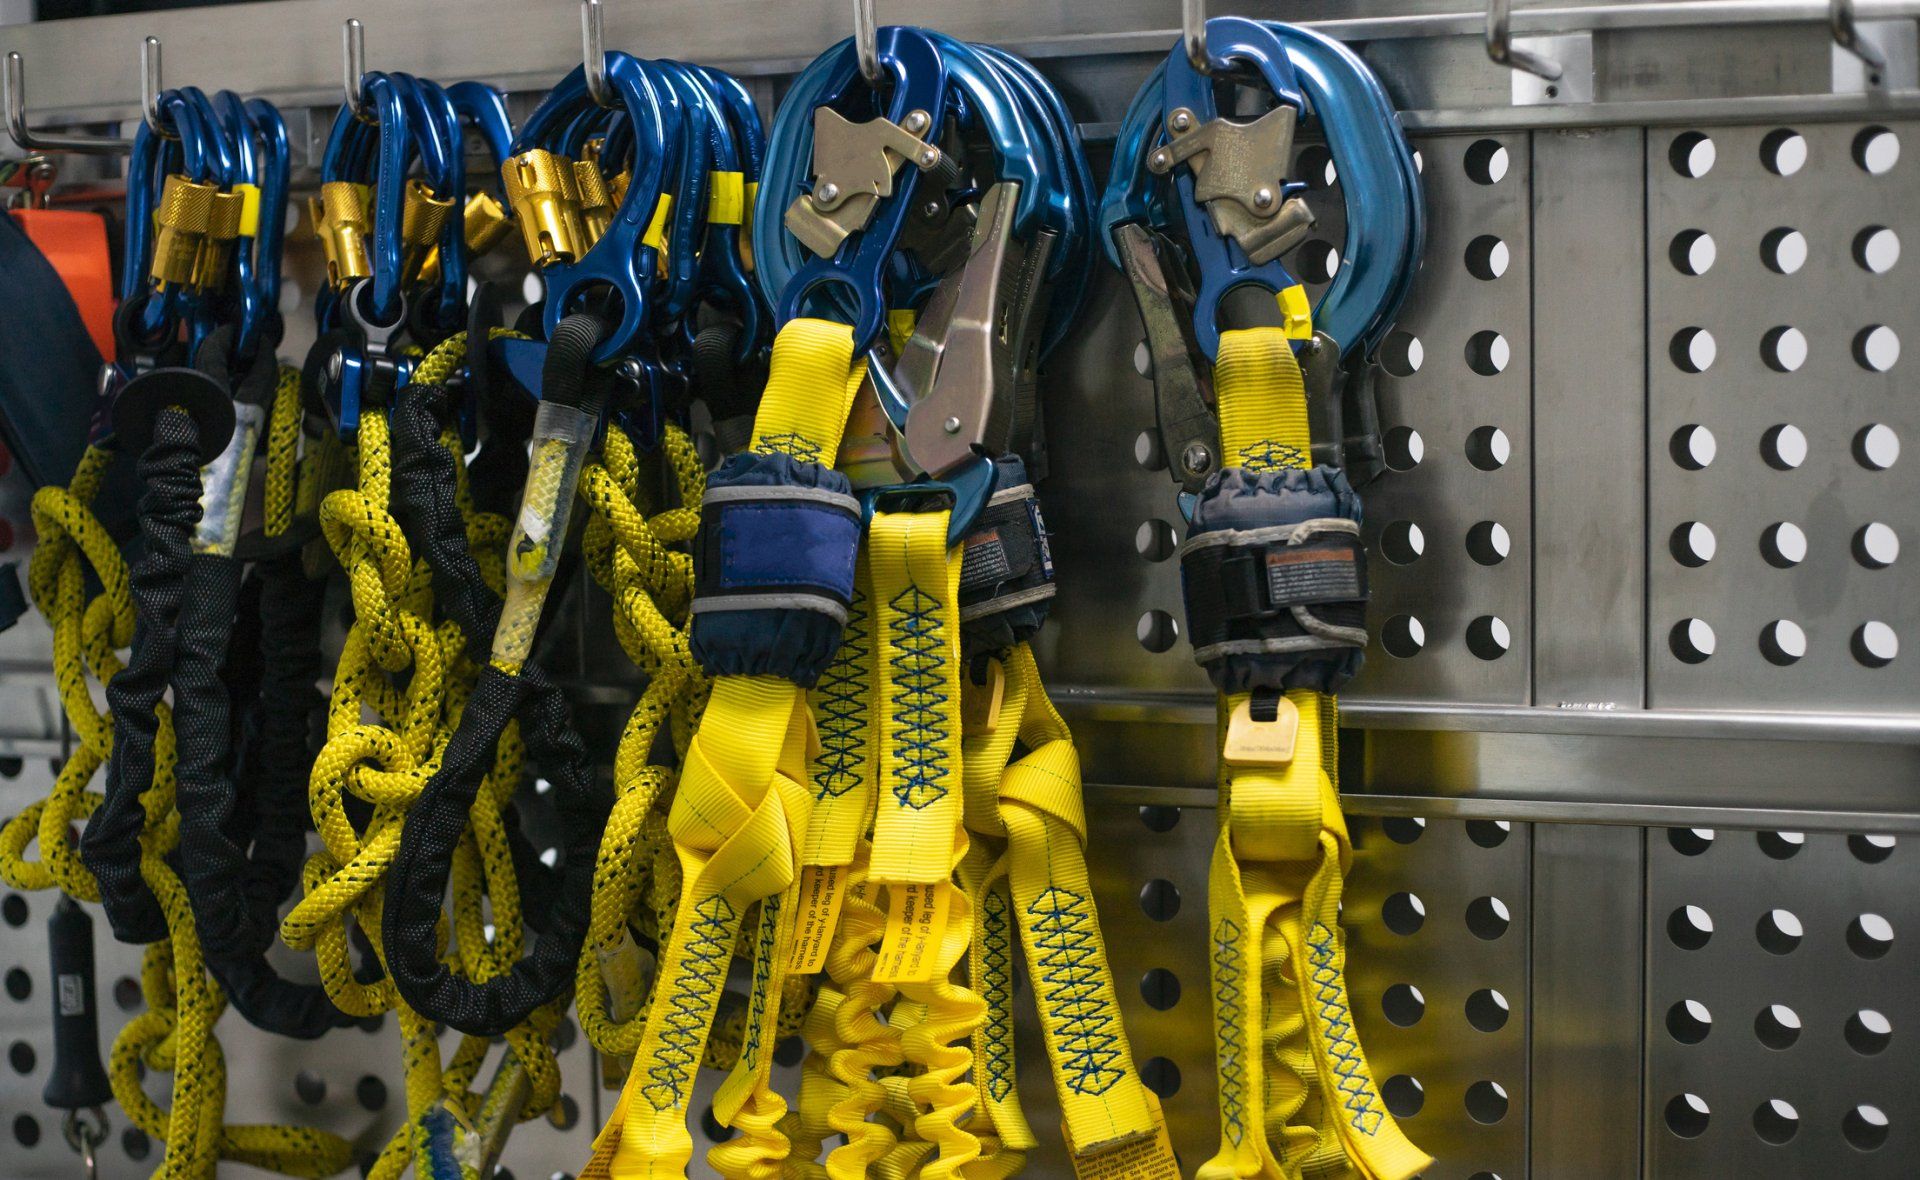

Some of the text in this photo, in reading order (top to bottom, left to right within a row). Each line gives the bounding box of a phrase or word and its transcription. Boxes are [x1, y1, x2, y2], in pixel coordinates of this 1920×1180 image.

[810, 878, 823, 908] keeper
[822, 892, 834, 906] leg
[808, 910, 816, 919] of
[821, 907, 830, 917] of
[902, 896, 919, 925] keeper
[919, 911, 935, 924] leg
[805, 921, 815, 934] the
[901, 927, 912, 936] of
[920, 926, 931, 935] of
[807, 959, 817, 967] to
